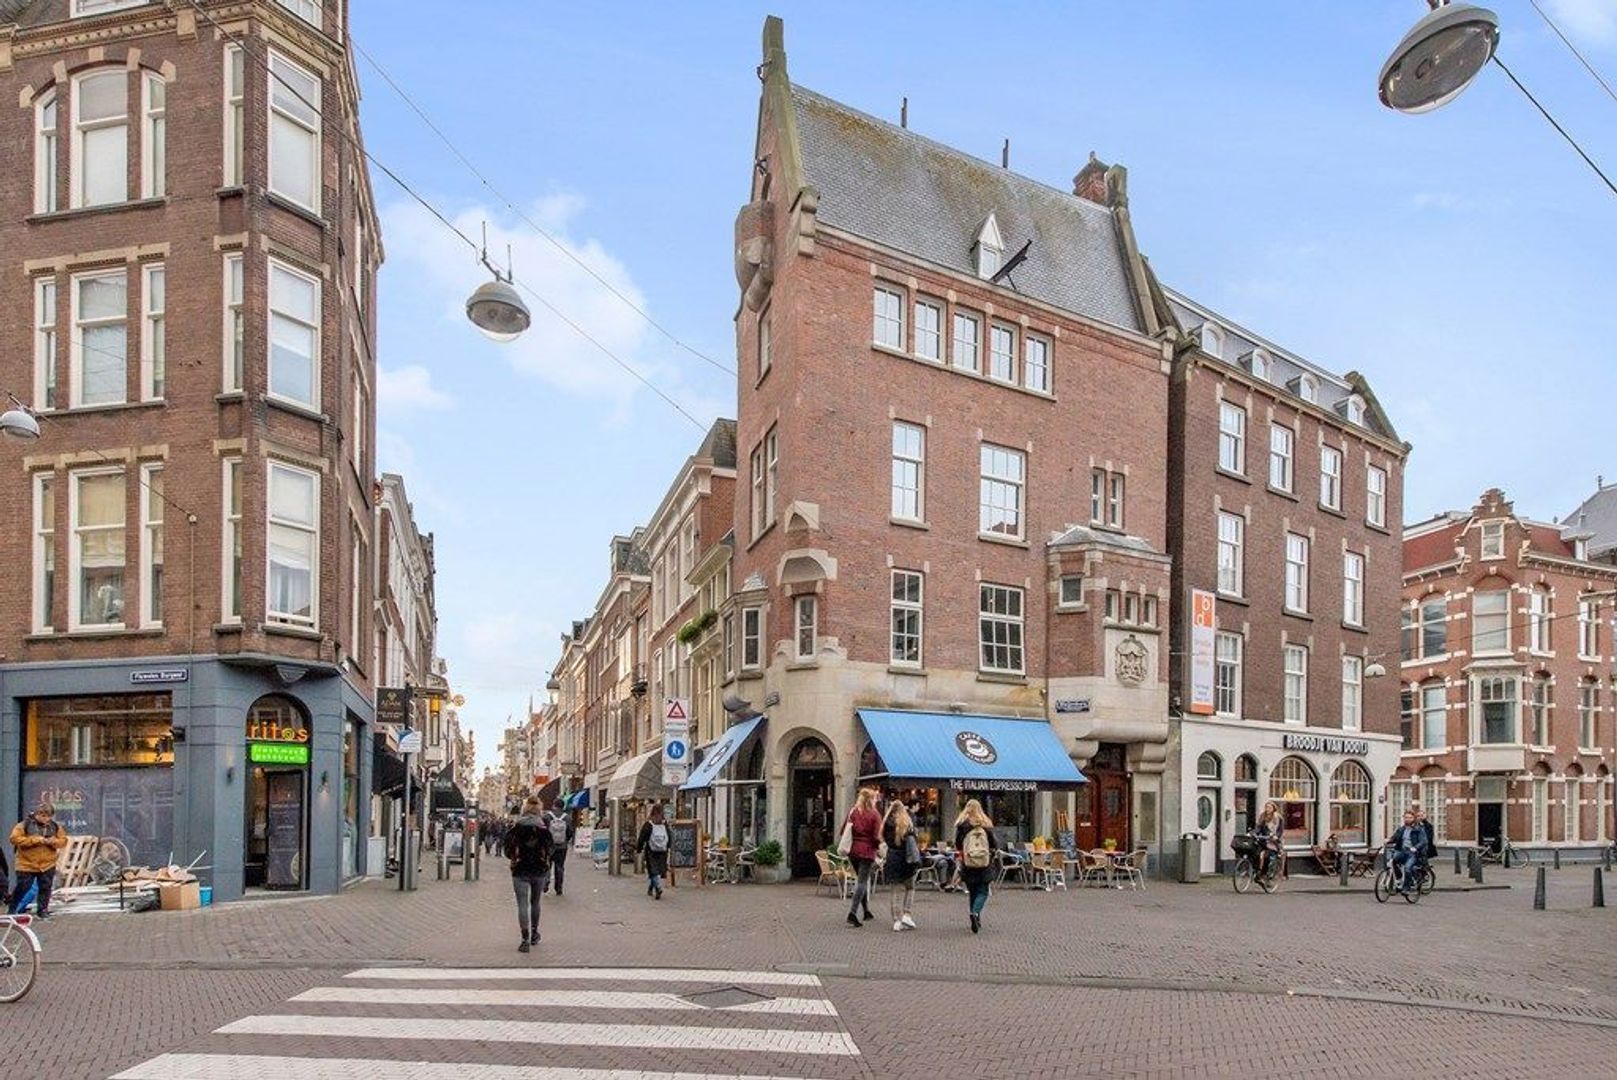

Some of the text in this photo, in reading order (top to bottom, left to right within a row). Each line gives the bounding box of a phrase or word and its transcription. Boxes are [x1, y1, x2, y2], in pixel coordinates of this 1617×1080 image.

[1286, 734, 1325, 752] BROODJE
[1326, 738, 1342, 754] VAN
[950, 779, 1038, 791] THE ITALIAN ESPRESSO BAR
